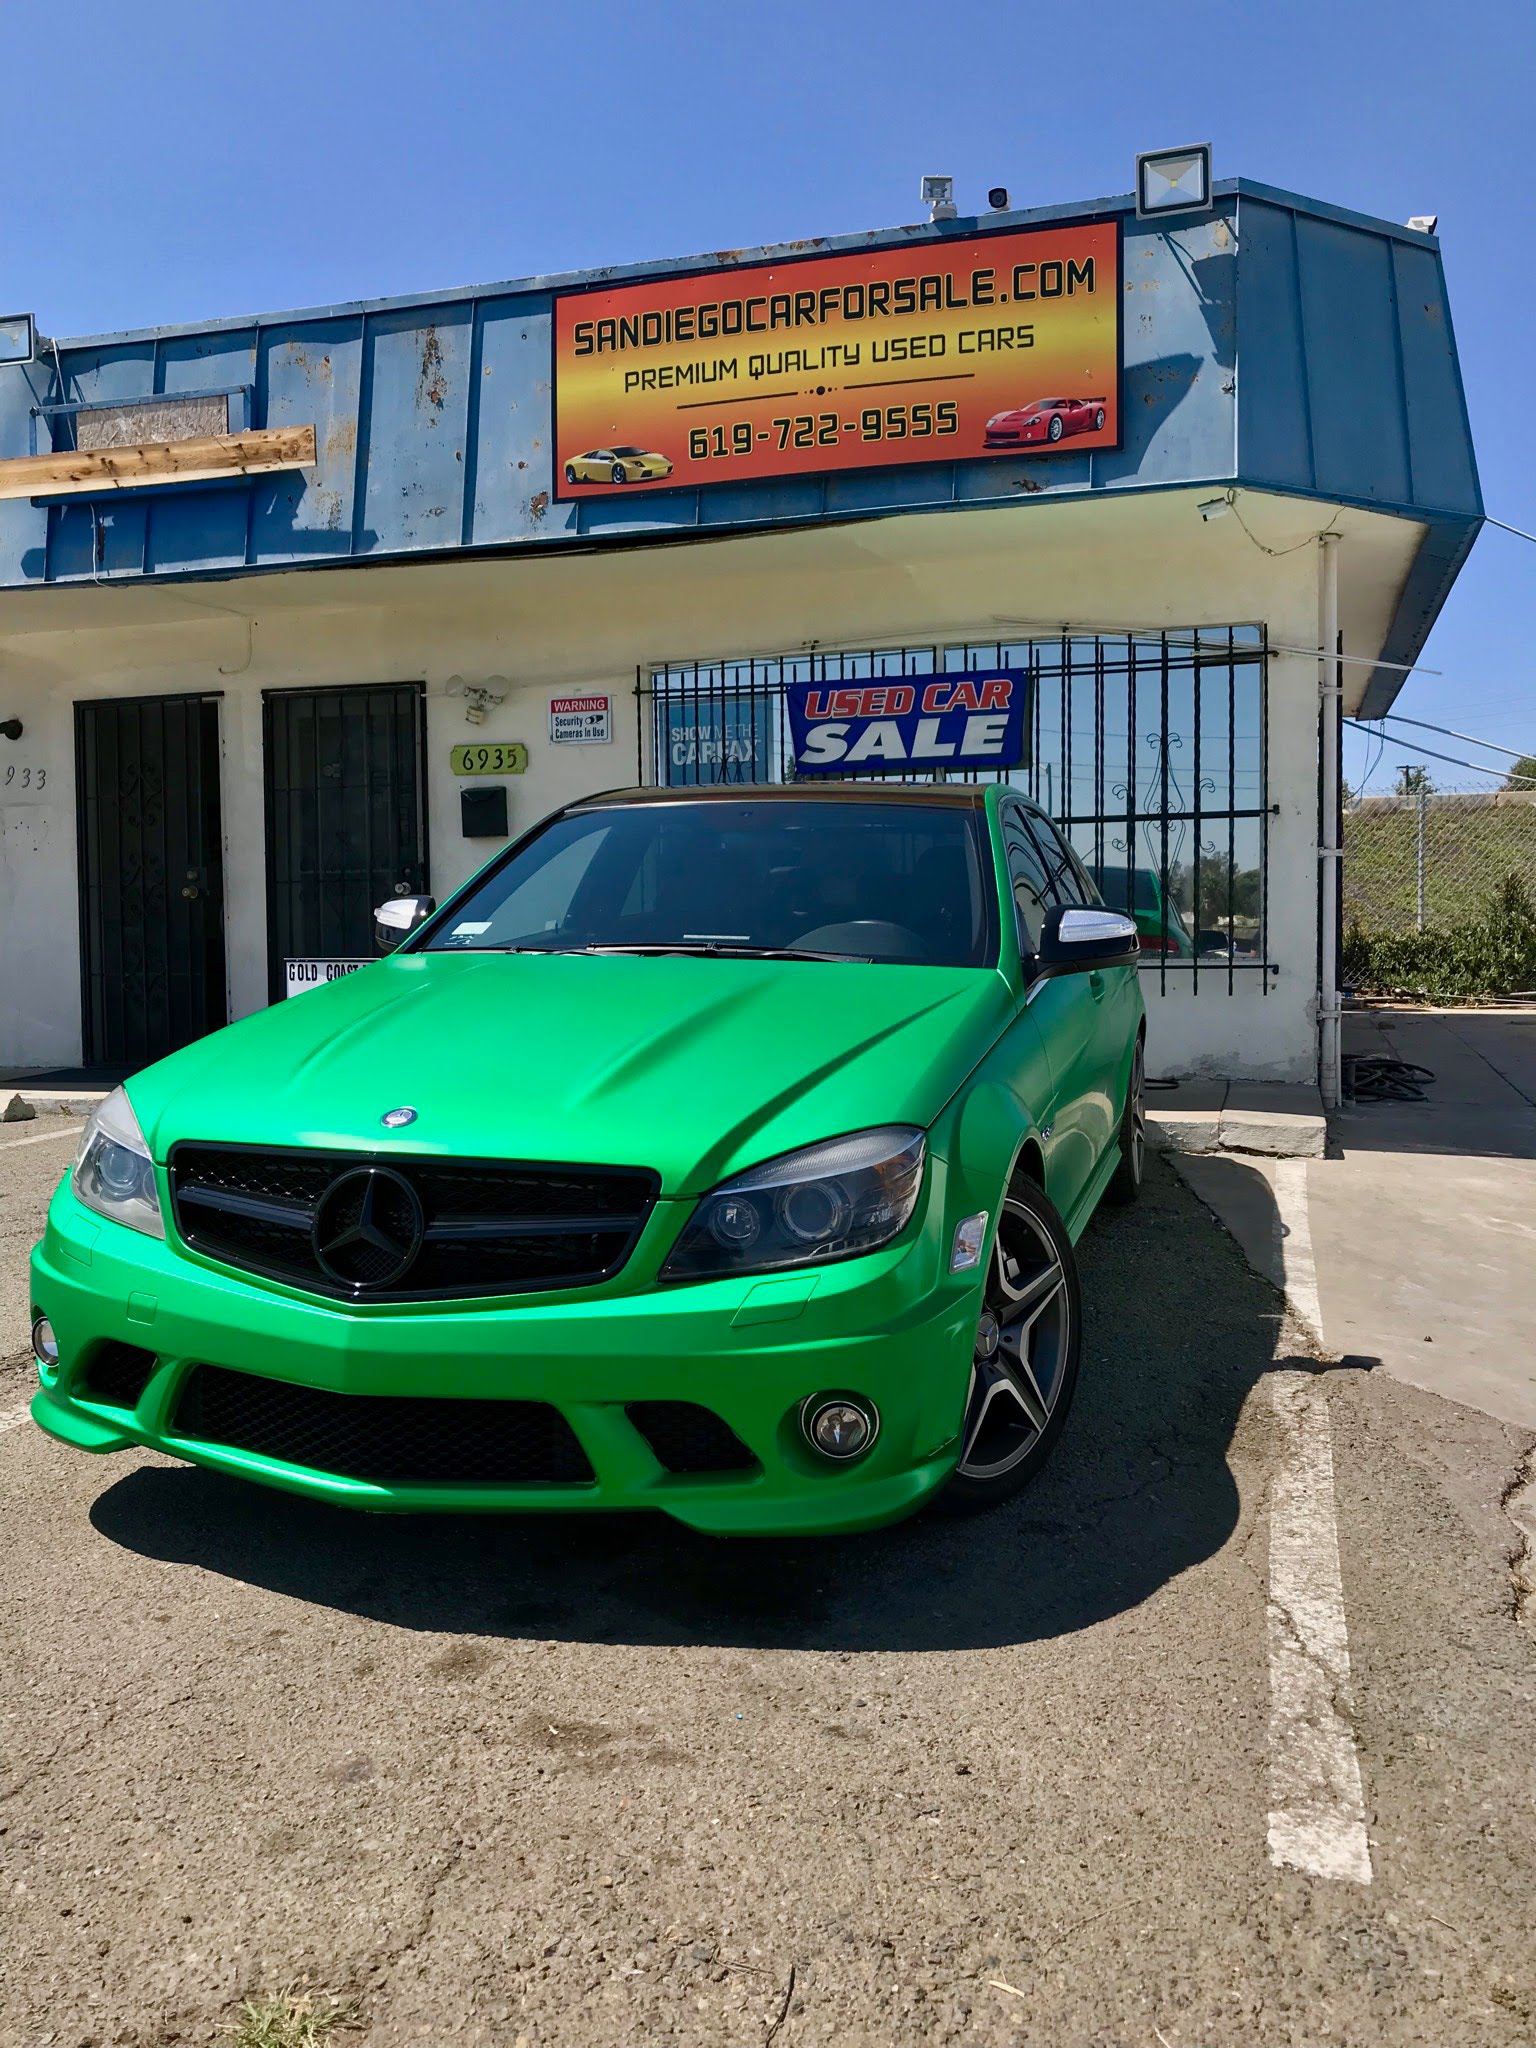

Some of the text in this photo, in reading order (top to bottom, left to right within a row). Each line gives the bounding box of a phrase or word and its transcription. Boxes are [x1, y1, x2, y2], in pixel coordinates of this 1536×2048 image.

[574, 256, 1097, 357] SANDIEGOCARFORSALE.COM
[624, 325, 1035, 393] PREMIUM QUALITY USED CARS
[688, 401, 958, 461] 619-722-9555
[554, 699, 605, 712] WARNING
[804, 679, 1013, 720] USED CAR
[555, 716, 583, 727] Security
[555, 727, 605, 739] Cameras In Use
[798, 713, 1010, 765] SALE
[462, 748, 517, 771] 6935
[289, 963, 318, 981] GOLD
